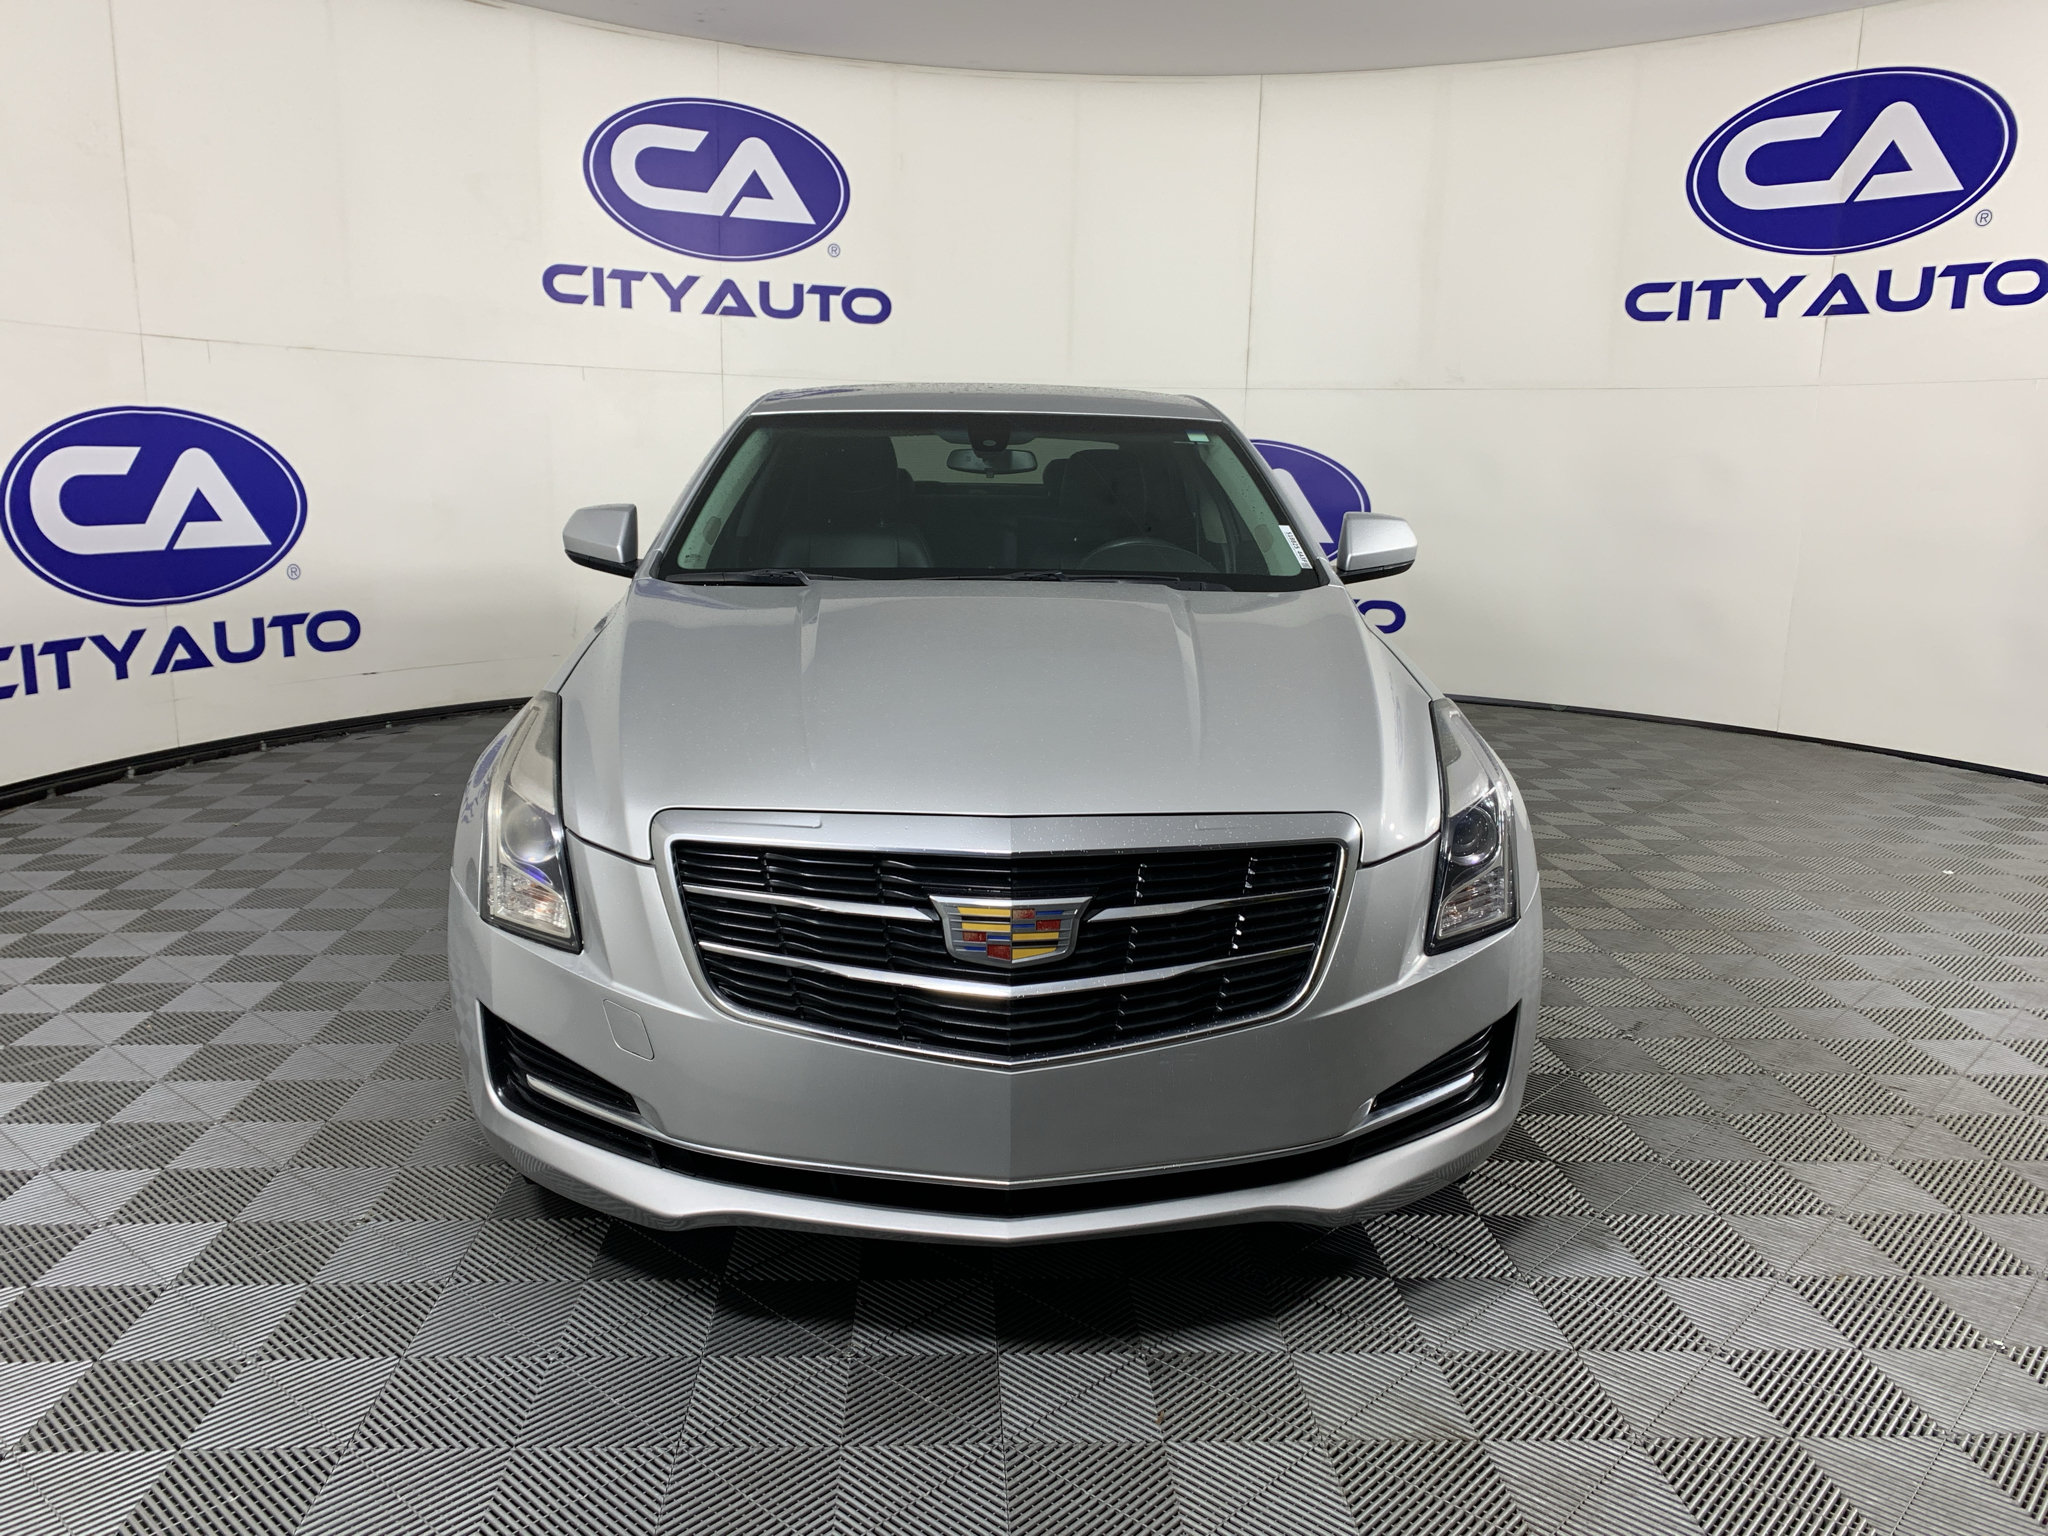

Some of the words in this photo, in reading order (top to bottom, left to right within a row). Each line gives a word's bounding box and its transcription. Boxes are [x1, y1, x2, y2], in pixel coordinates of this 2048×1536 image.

[610, 123, 816, 225] CA
[1717, 101, 1965, 211] CA
[29, 445, 272, 555] CA
